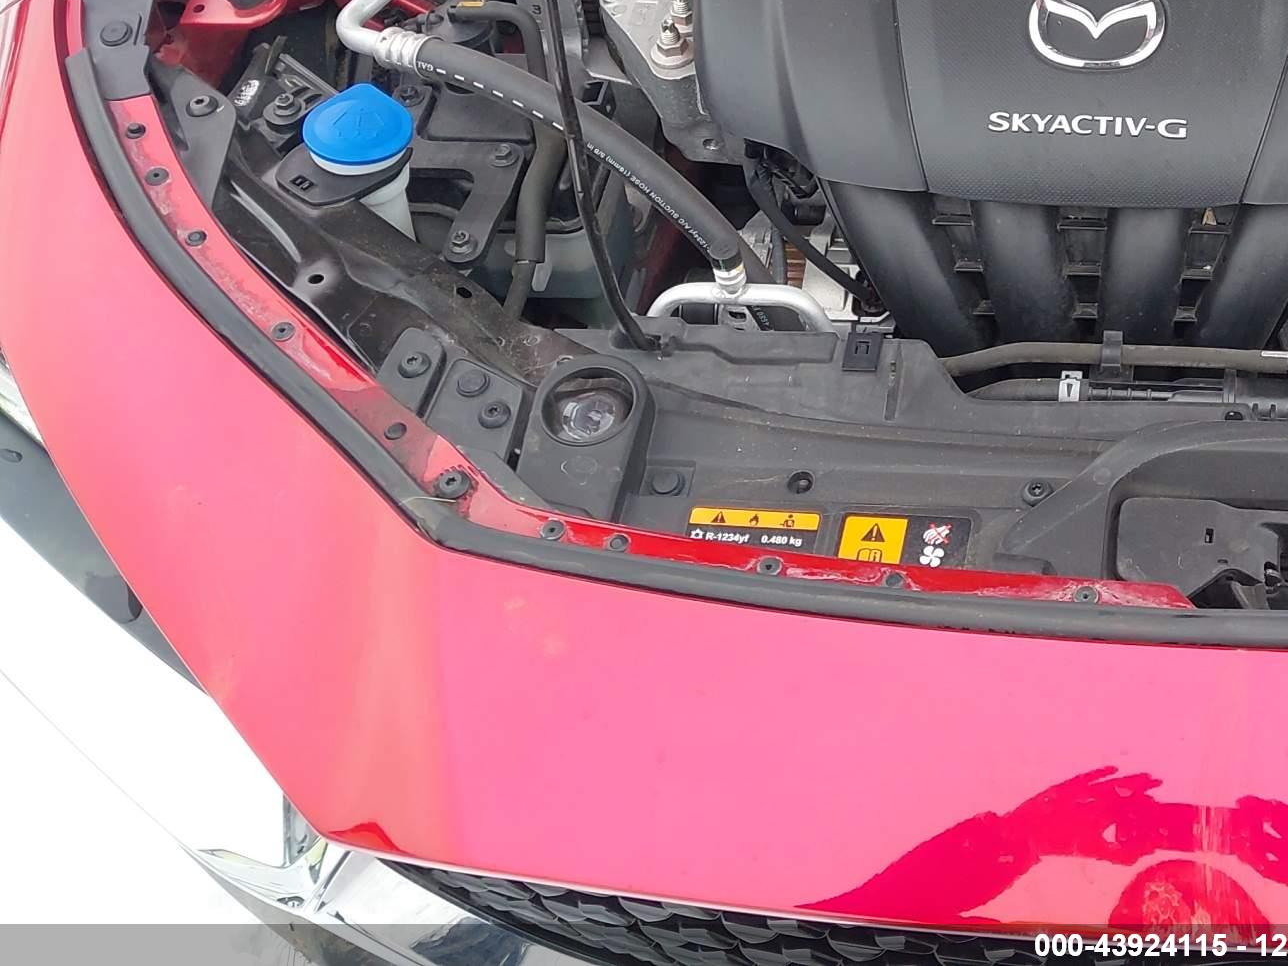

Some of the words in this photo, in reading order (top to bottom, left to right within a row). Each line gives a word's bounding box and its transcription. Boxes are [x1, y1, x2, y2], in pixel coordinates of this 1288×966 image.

[988, 111, 1187, 139] SKYACTIV-G
[627, 174, 652, 194] HOSE
[648, 190, 680, 220] SUCTION
[687, 229, 712, 252] -1234yf
[705, 532, 749, 545] R-1234yf
[761, 535, 789, 546] 0.480
[790, 536, 802, 547] kg
